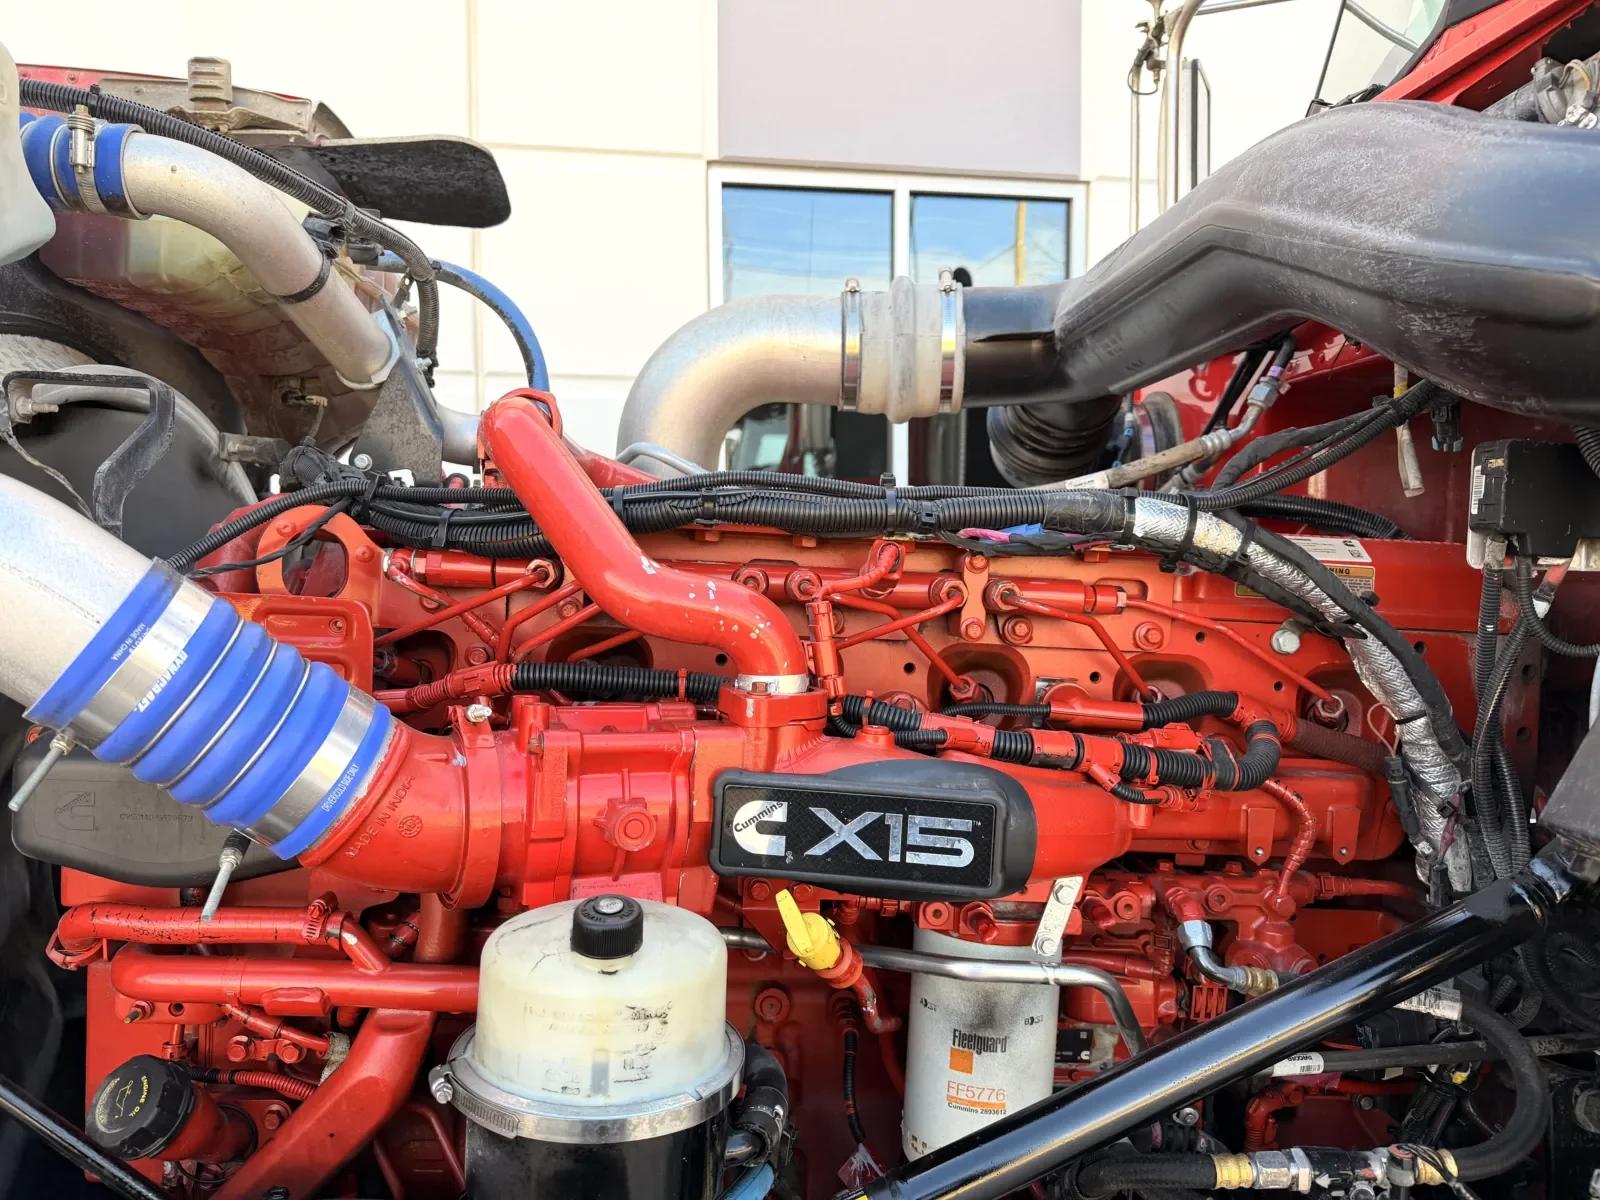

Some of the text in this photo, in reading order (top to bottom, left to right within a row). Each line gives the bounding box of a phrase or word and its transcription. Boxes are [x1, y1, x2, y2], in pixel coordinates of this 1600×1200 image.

[345, 825, 378, 857] MADE
[376, 813, 391, 827] IN
[388, 775, 416, 812] INDIA
[734, 801, 784, 833] Cummins
[803, 807, 975, 868] X15
[952, 1028, 1008, 1055] Fleetguard
[128, 1075, 149, 1118] ENGINE OIL
[947, 1080, 1006, 1102] FF5776
[948, 1102, 979, 1115] Cummins
